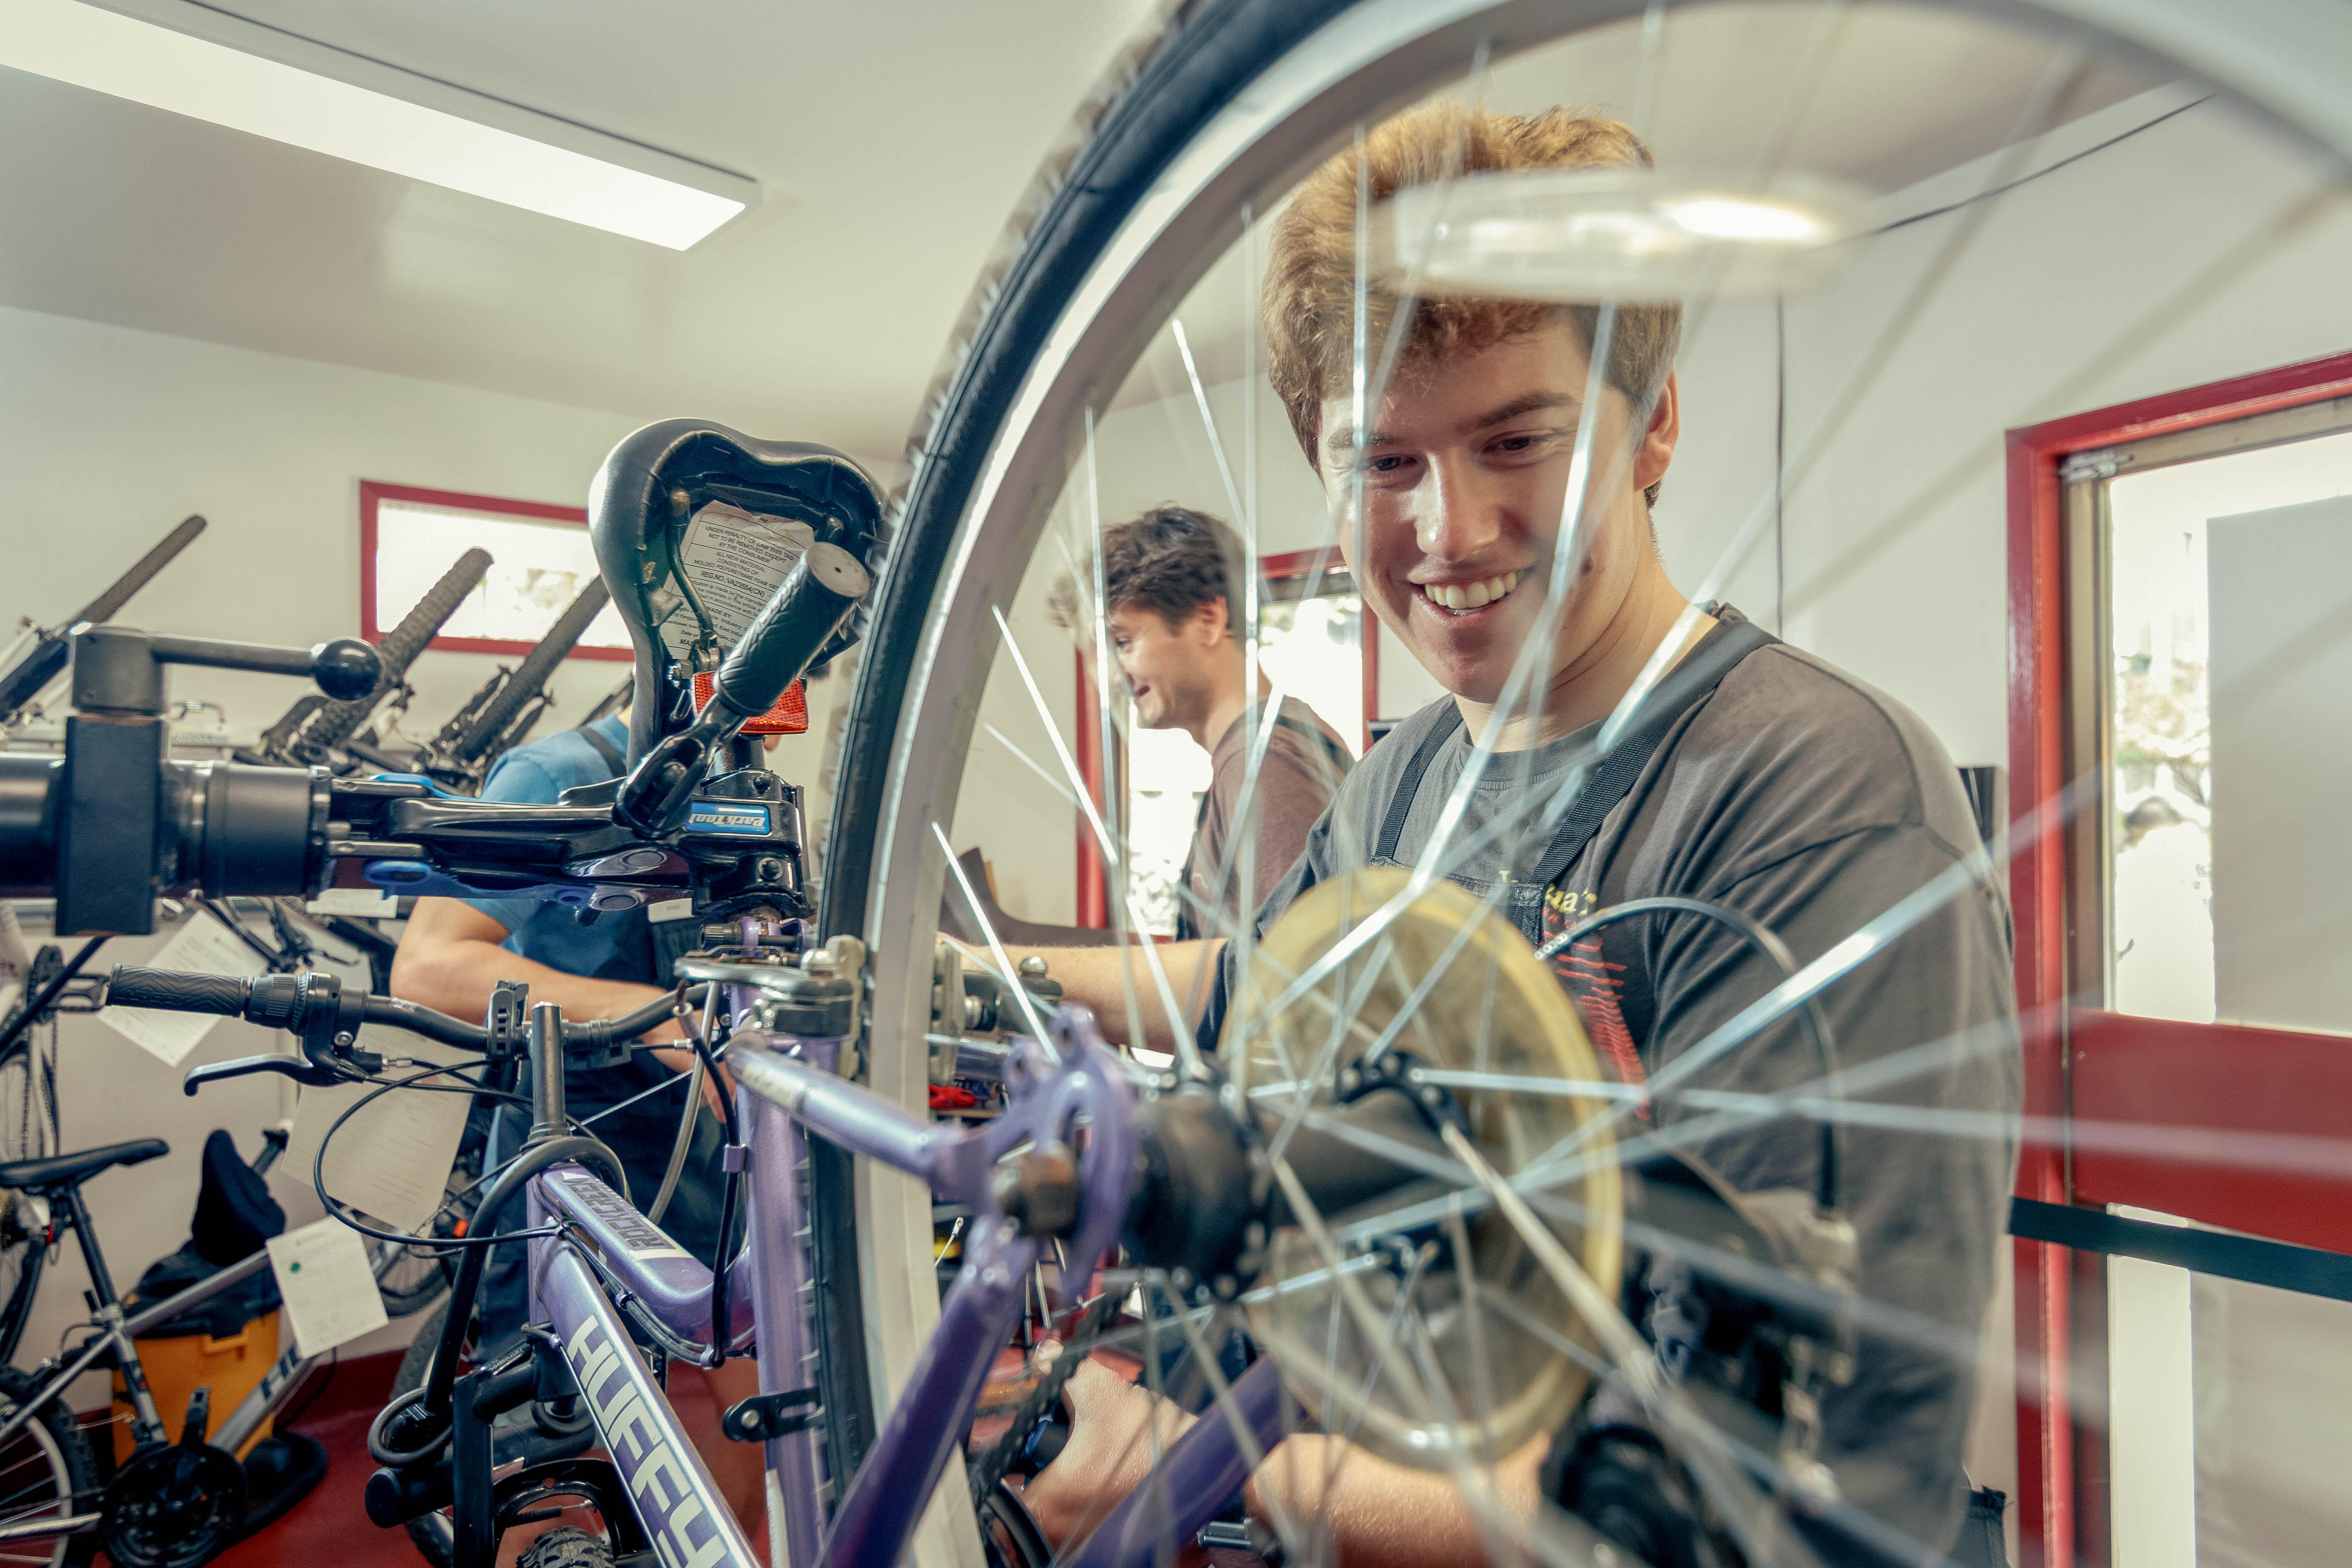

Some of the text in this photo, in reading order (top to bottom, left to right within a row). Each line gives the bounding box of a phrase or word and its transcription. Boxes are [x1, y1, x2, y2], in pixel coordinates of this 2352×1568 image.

[724, 530, 748, 540] PENALTY
[737, 540, 763, 554] REMOVED
[764, 551, 786, 563] EXCEPT
[738, 548, 770, 563] CONSUMER
[717, 558, 750, 572] CONSISTING
[740, 559, 766, 572] MATERIAL
[716, 564, 754, 580] POLYURETHANE
[754, 577, 768, 586] FOAM
[706, 590, 727, 599] materials
[714, 598, 741, 610] accordance
[707, 606, 723, 615] MADE
[721, 618, 742, 630] Industry
